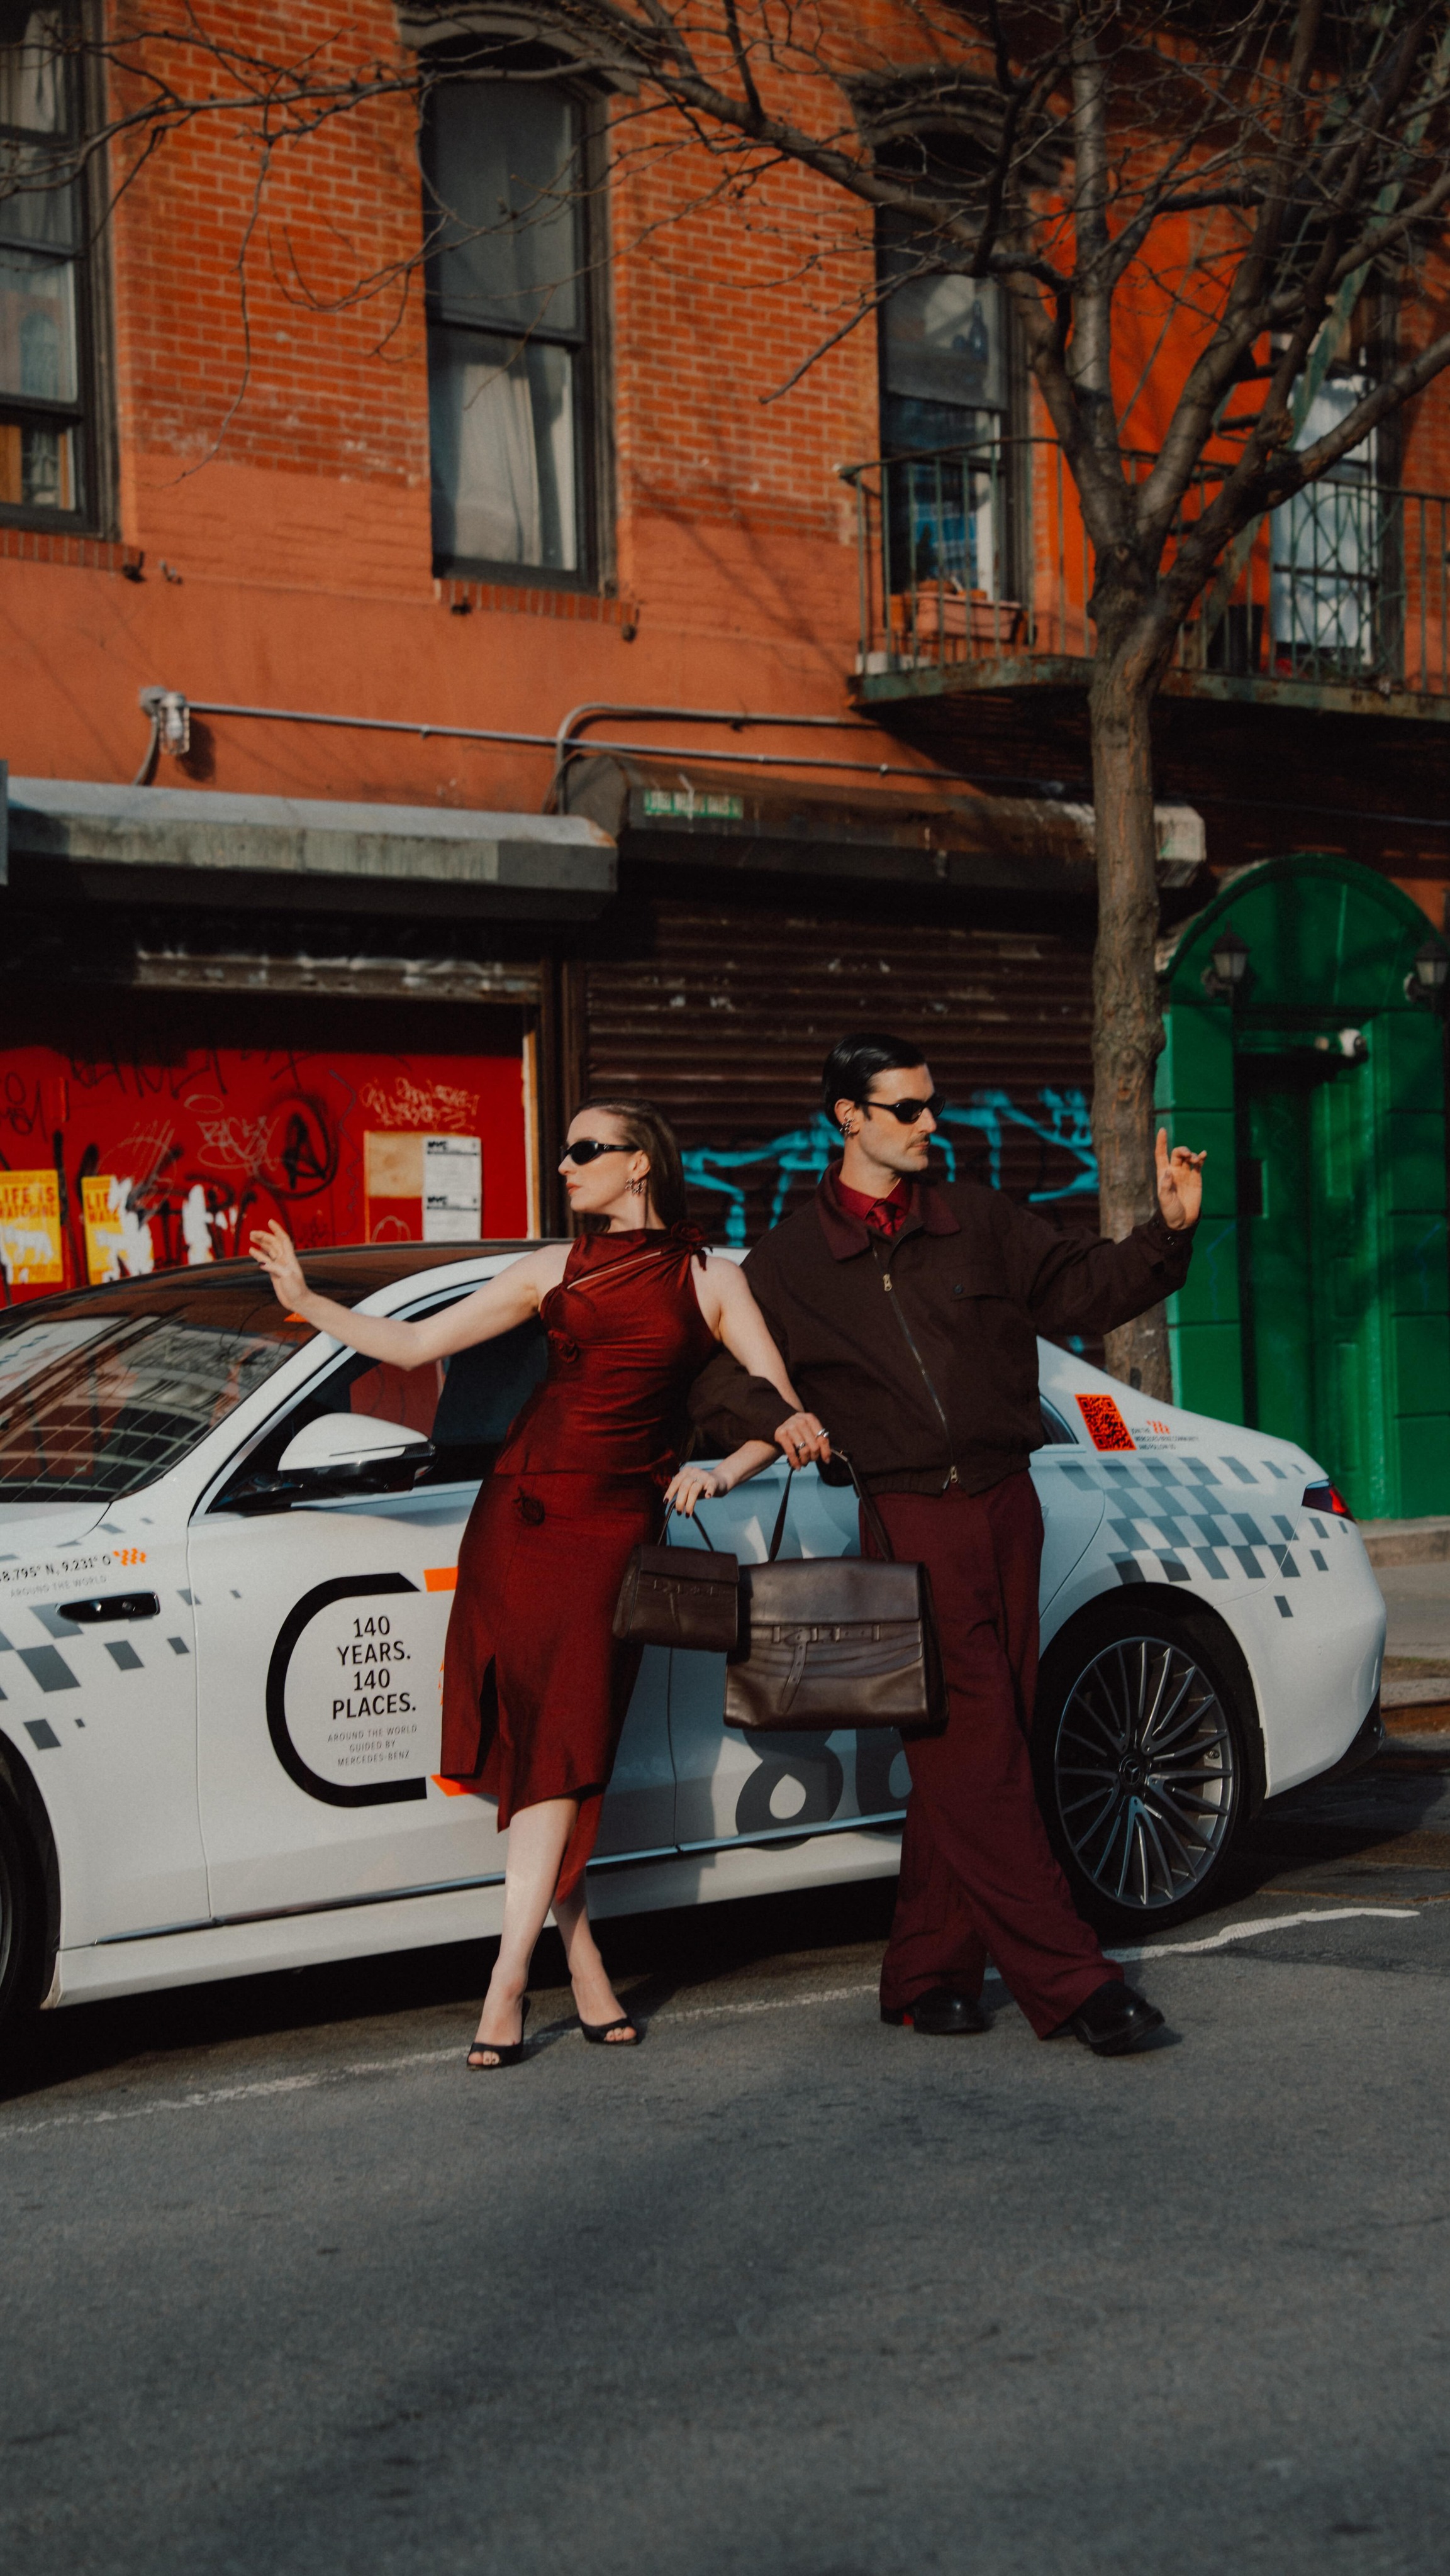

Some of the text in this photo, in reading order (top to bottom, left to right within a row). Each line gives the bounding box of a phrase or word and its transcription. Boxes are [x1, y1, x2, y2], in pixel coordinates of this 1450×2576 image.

[0, 1566, 40, 1582] 8.795°
[11, 1575, 107, 1598] AROUND THE WORLD
[353, 1616, 390, 1638] 140
[337, 1641, 411, 1666] YEARS.
[354, 1668, 390, 1692] 140
[333, 1692, 416, 1720] PLACES.
[327, 1724, 418, 1743] AROUND THE WORLD
[350, 1740, 396, 1753] GUIDED BY
[337, 1750, 410, 1767] MERCEDES-BENZ
